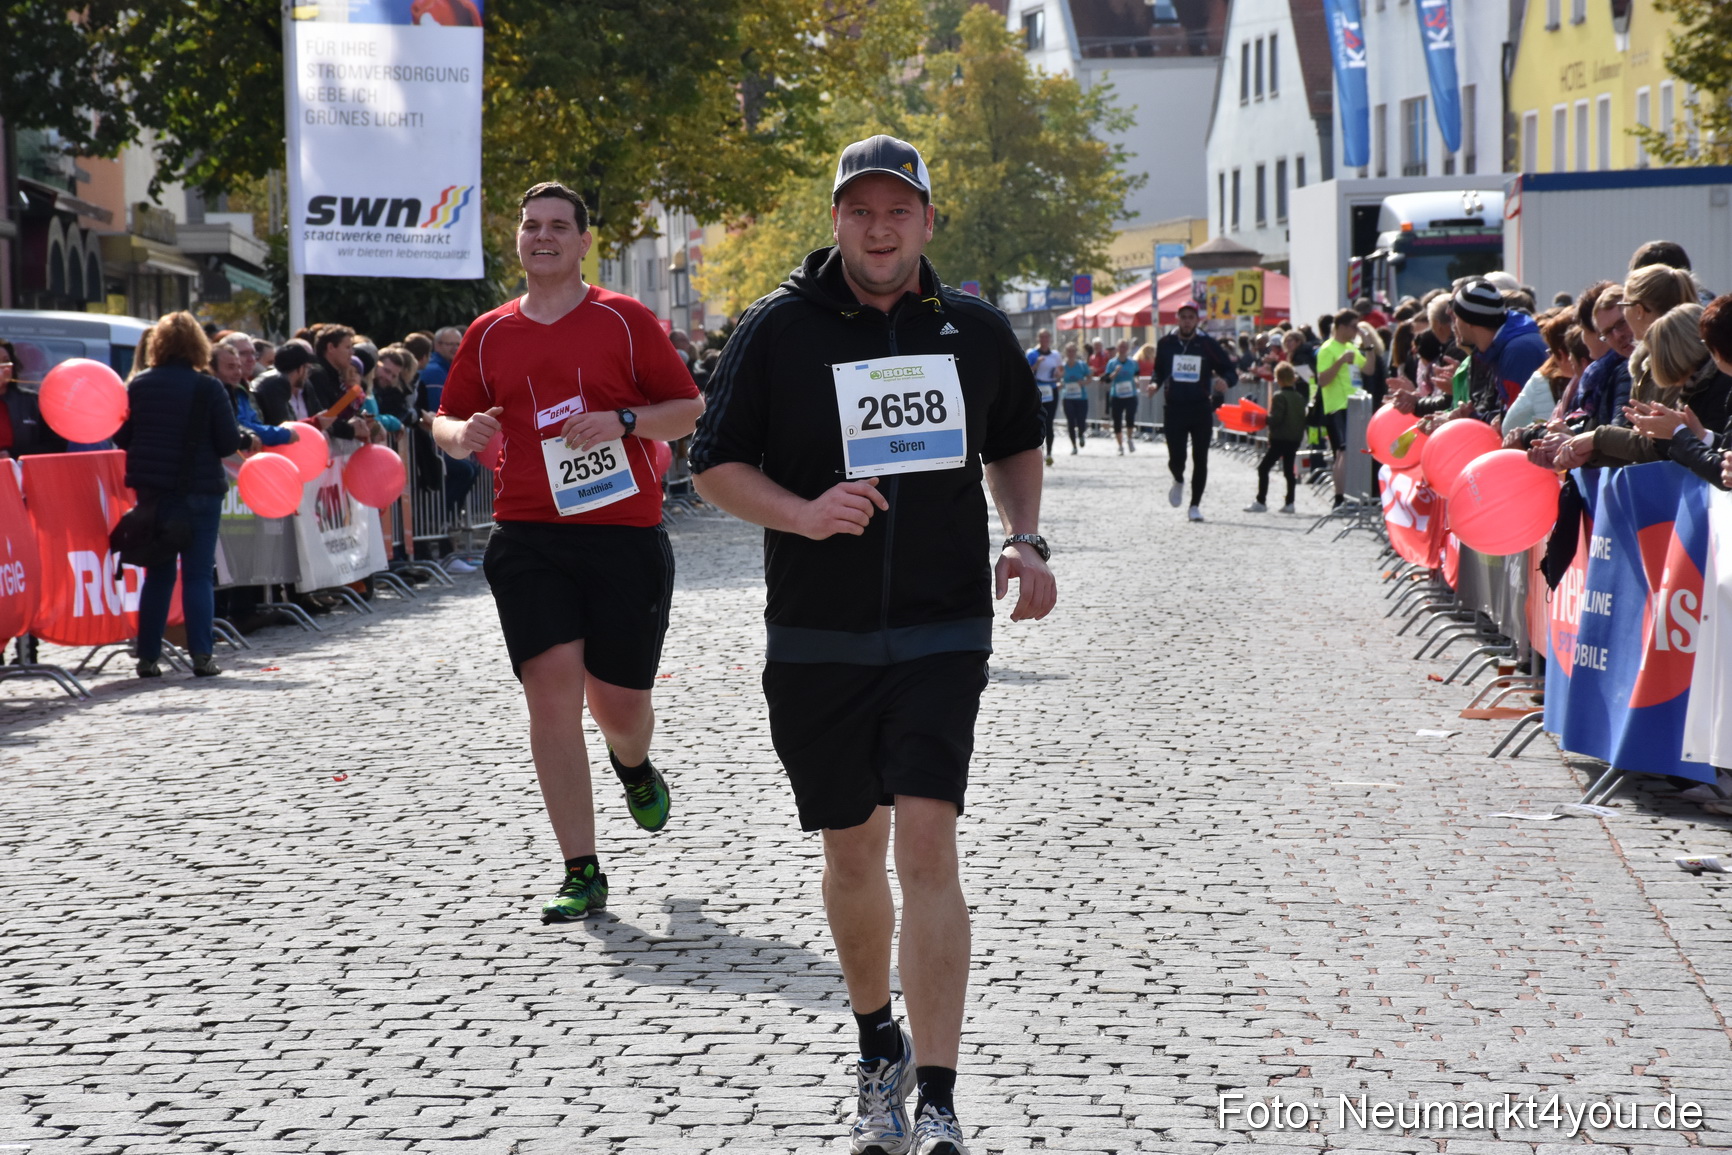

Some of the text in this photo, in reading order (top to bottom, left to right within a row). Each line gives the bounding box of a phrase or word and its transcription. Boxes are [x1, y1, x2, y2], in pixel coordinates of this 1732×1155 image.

[306, 37, 377, 57] FÜR IHRE
[306, 63, 470, 83] STROMVERSORGUNG
[305, 87, 377, 103] GEBE ICH
[305, 107, 424, 127] GRÜNES LICHT!
[304, 195, 422, 228] swn
[303, 230, 452, 245] stadtwerke neumarkt
[337, 248, 354, 257] wir
[357, 247, 394, 258] bieten
[1242, 284, 1257, 306] D
[939, 328, 960, 336] adidas
[883, 367, 923, 378] BOCK
[1176, 362, 1197, 372] 2404
[550, 404, 571, 420] DEHN
[858, 389, 947, 431] 2658
[890, 440, 926, 454] Sören
[559, 446, 616, 485] 2535
[578, 481, 614, 499] Matthias
[1591, 535, 1612, 560] ORE
[1573, 642, 1608, 671] OBILE
